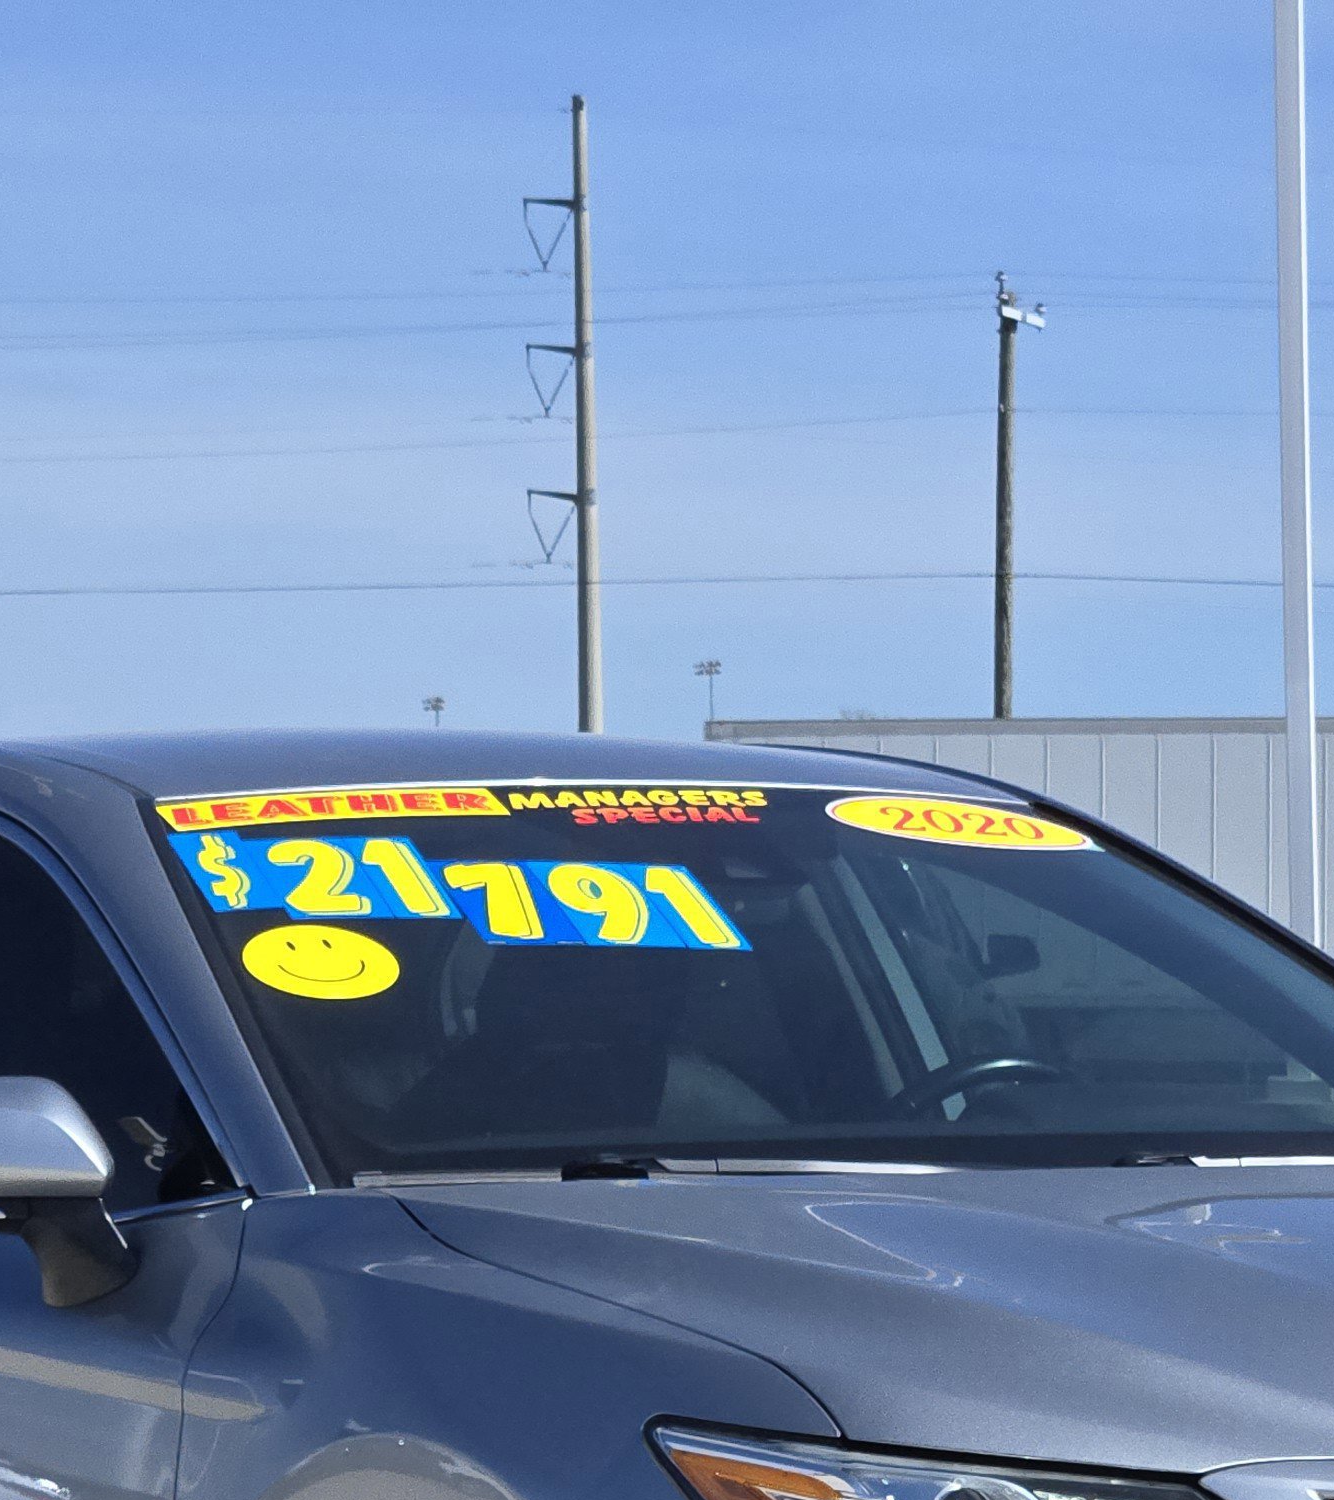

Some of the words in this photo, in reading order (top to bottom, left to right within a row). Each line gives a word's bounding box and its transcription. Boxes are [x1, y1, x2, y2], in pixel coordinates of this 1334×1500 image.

[171, 792, 490, 826] LEATHER
[508, 790, 767, 809] MANAGERS
[571, 807, 761, 825] SPECIAL
[879, 806, 1044, 840] 2020
